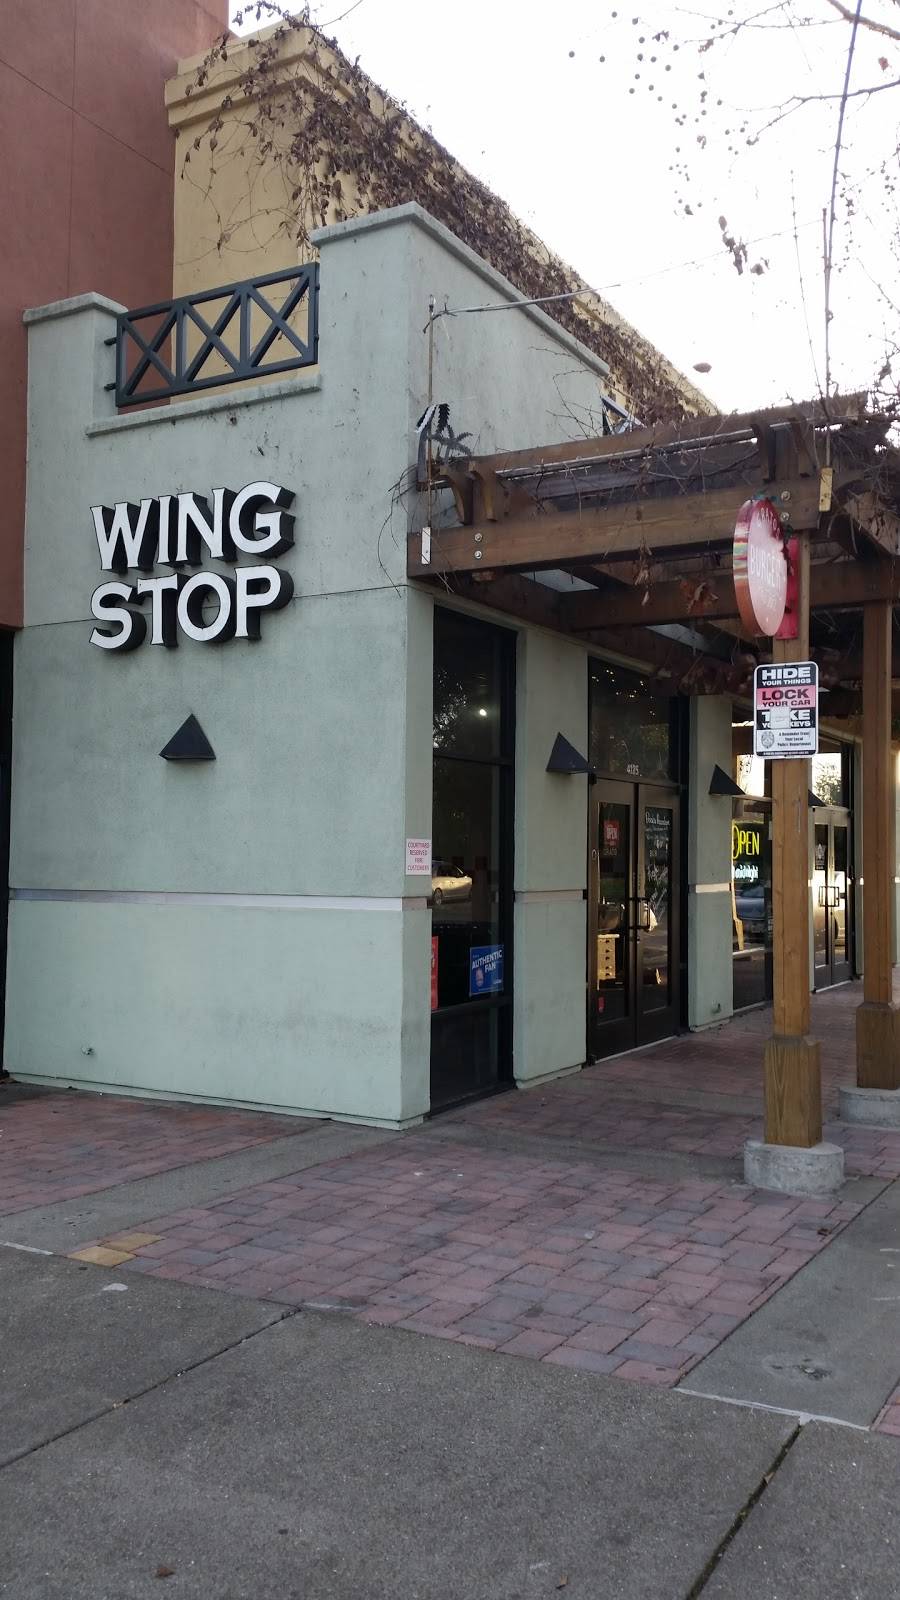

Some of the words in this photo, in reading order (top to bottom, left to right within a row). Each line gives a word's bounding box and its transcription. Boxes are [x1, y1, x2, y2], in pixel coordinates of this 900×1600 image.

[90, 481, 293, 574] WING
[89, 565, 292, 651] STOP
[762, 667, 811, 680] HIDE
[762, 688, 809, 701] LOCK
[762, 709, 811, 721] TKE
[732, 825, 760, 859] OPEN
[472, 949, 503, 970] AUTHENTIC
[484, 961, 496, 973] FAN
